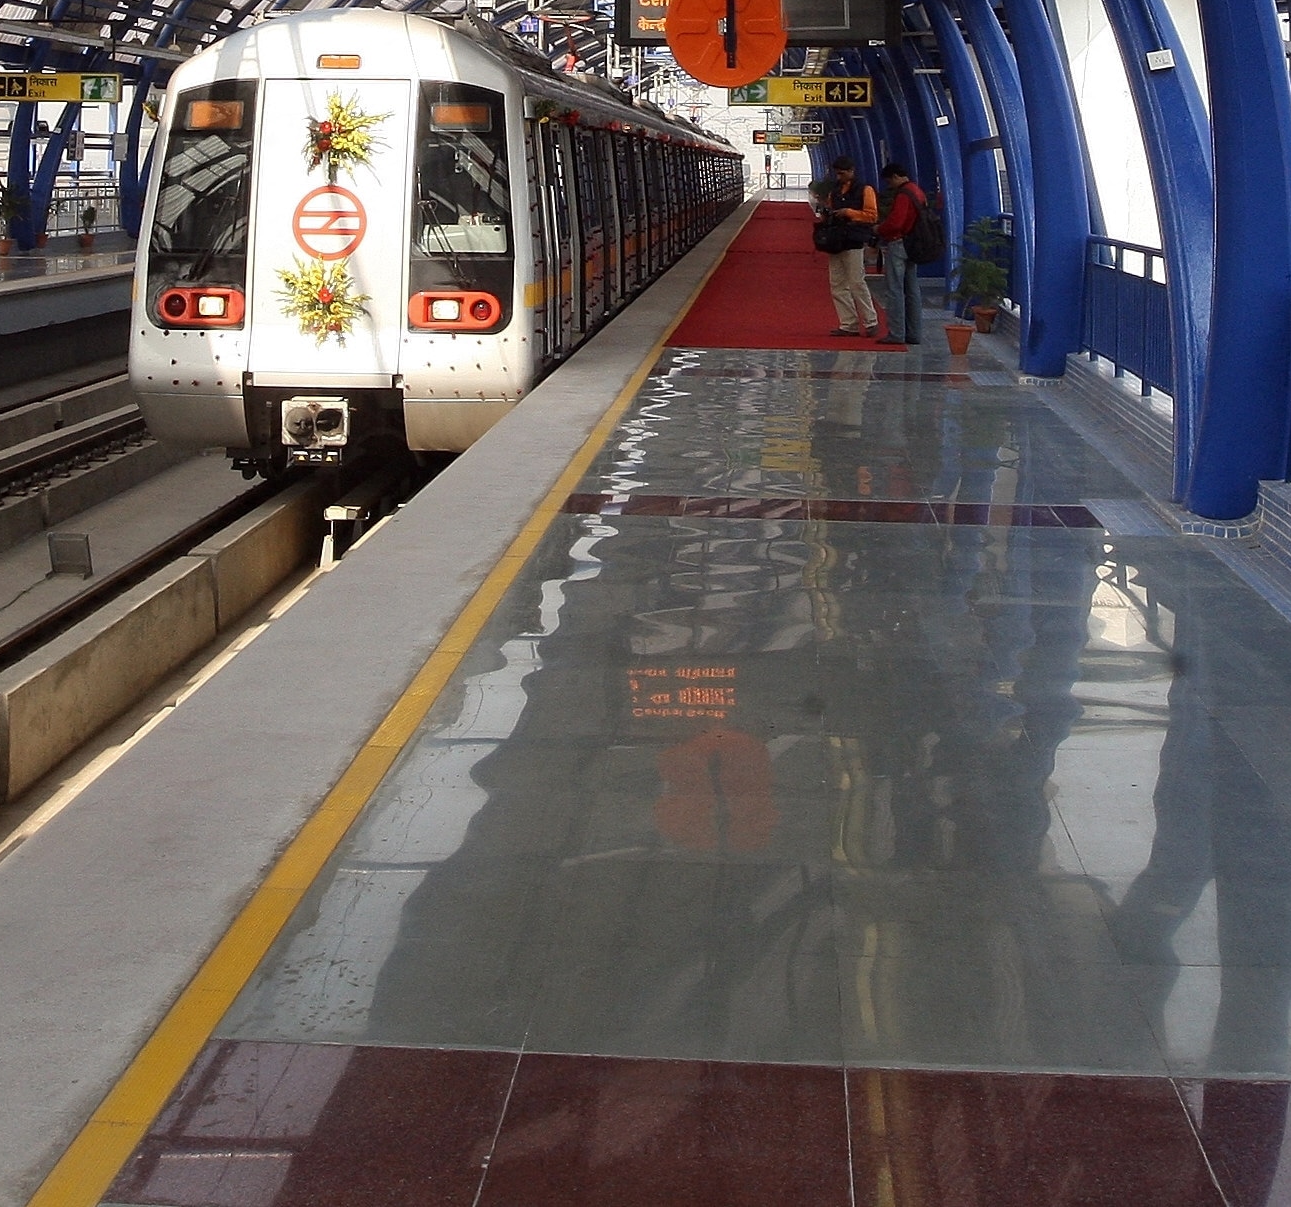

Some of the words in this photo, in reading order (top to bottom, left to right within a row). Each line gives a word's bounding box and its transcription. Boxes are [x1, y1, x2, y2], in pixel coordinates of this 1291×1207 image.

[29, 75, 57, 86] निकास
[793, 79, 822, 90] निकास
[29, 90, 45, 98] Exit
[804, 94, 822, 103] Exit
